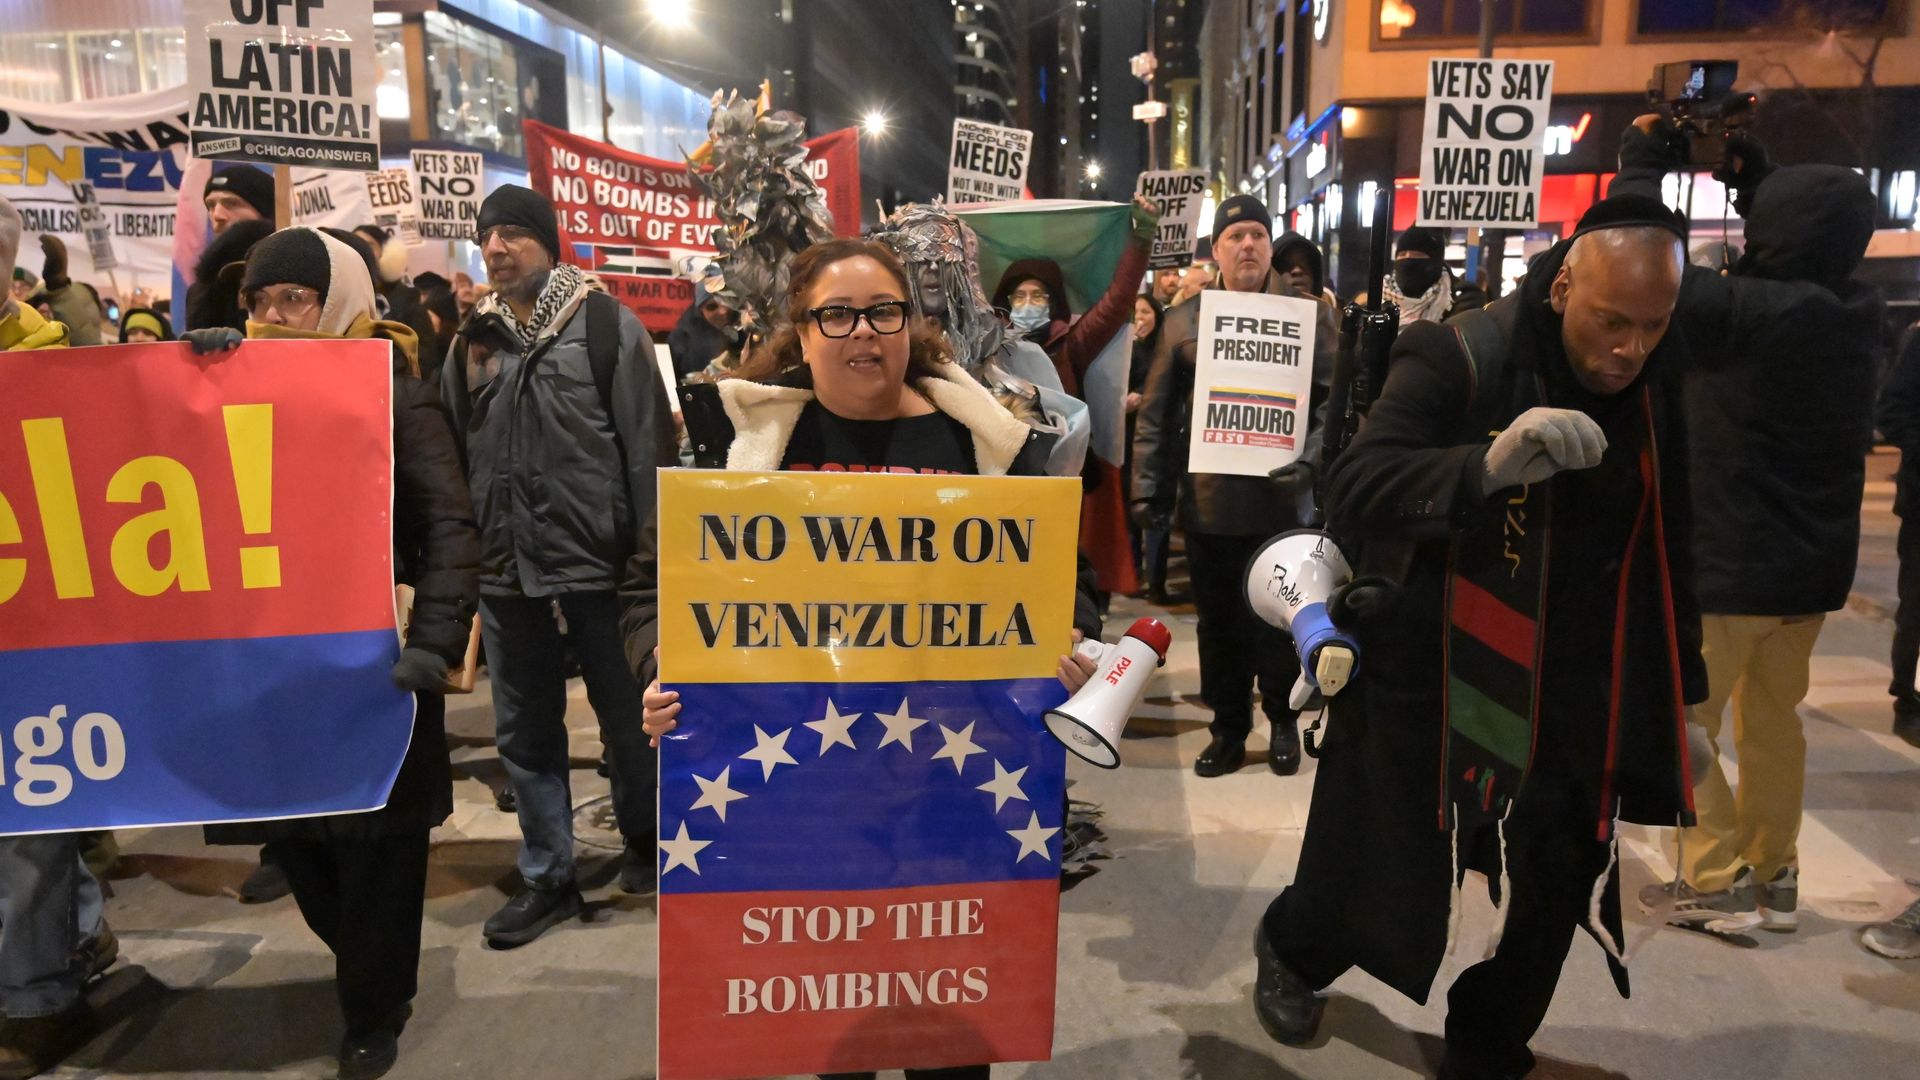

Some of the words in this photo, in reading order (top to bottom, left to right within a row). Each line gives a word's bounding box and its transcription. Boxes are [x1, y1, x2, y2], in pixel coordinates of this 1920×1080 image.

[210, 38, 353, 97] LATIN
[1432, 60, 1493, 99] VETS
[1501, 62, 1551, 100] SAY
[194, 92, 371, 139] AMERICA!
[1437, 102, 1534, 141] NO
[200, 138, 239, 152] ANSWER
[957, 130, 1026, 151] PEOPLE'S
[958, 122, 1001, 137] MONEY
[1003, 130, 1028, 142] FOR
[245, 143, 372, 163] @CHICAGOANSWER
[413, 153, 448, 174] VETS
[454, 154, 481, 175] SAY
[552, 146, 580, 171] NO
[586, 157, 658, 186] BOOTS
[662, 172, 691, 189] ON
[954, 140, 1023, 180] NEEDS
[1433, 147, 1491, 186] WAR
[1498, 148, 1533, 186] ON
[421, 176, 475, 196] NO
[552, 175, 589, 204] NO
[594, 179, 690, 219] BOMBS
[953, 176, 971, 191] NOT
[973, 179, 994, 195] WAR
[997, 184, 1020, 199] WITH
[1142, 175, 1205, 197] HANDS
[421, 200, 453, 220] WAR
[459, 201, 478, 221] ON
[1422, 190, 1535, 222] VENEZUELA
[417, 221, 476, 239] VENEZUEL
[600, 213, 641, 238] OUT
[646, 219, 676, 241] OF
[1153, 240, 1191, 255] ERICA!
[1214, 316, 1301, 340] FREE
[1213, 339, 1302, 367] PRESIDENT
[1206, 403, 1296, 437] MADURO
[699, 513, 787, 563] NO
[801, 515, 939, 564] WAR
[953, 517, 1035, 564] ON
[689, 600, 1037, 650] VENEZUELA
[1106, 656, 1132, 685] PYLE
[0, 704, 127, 807] go
[742, 905, 875, 946] STOP
[886, 897, 985, 942] THE
[725, 966, 988, 1016] BOMBINGS
